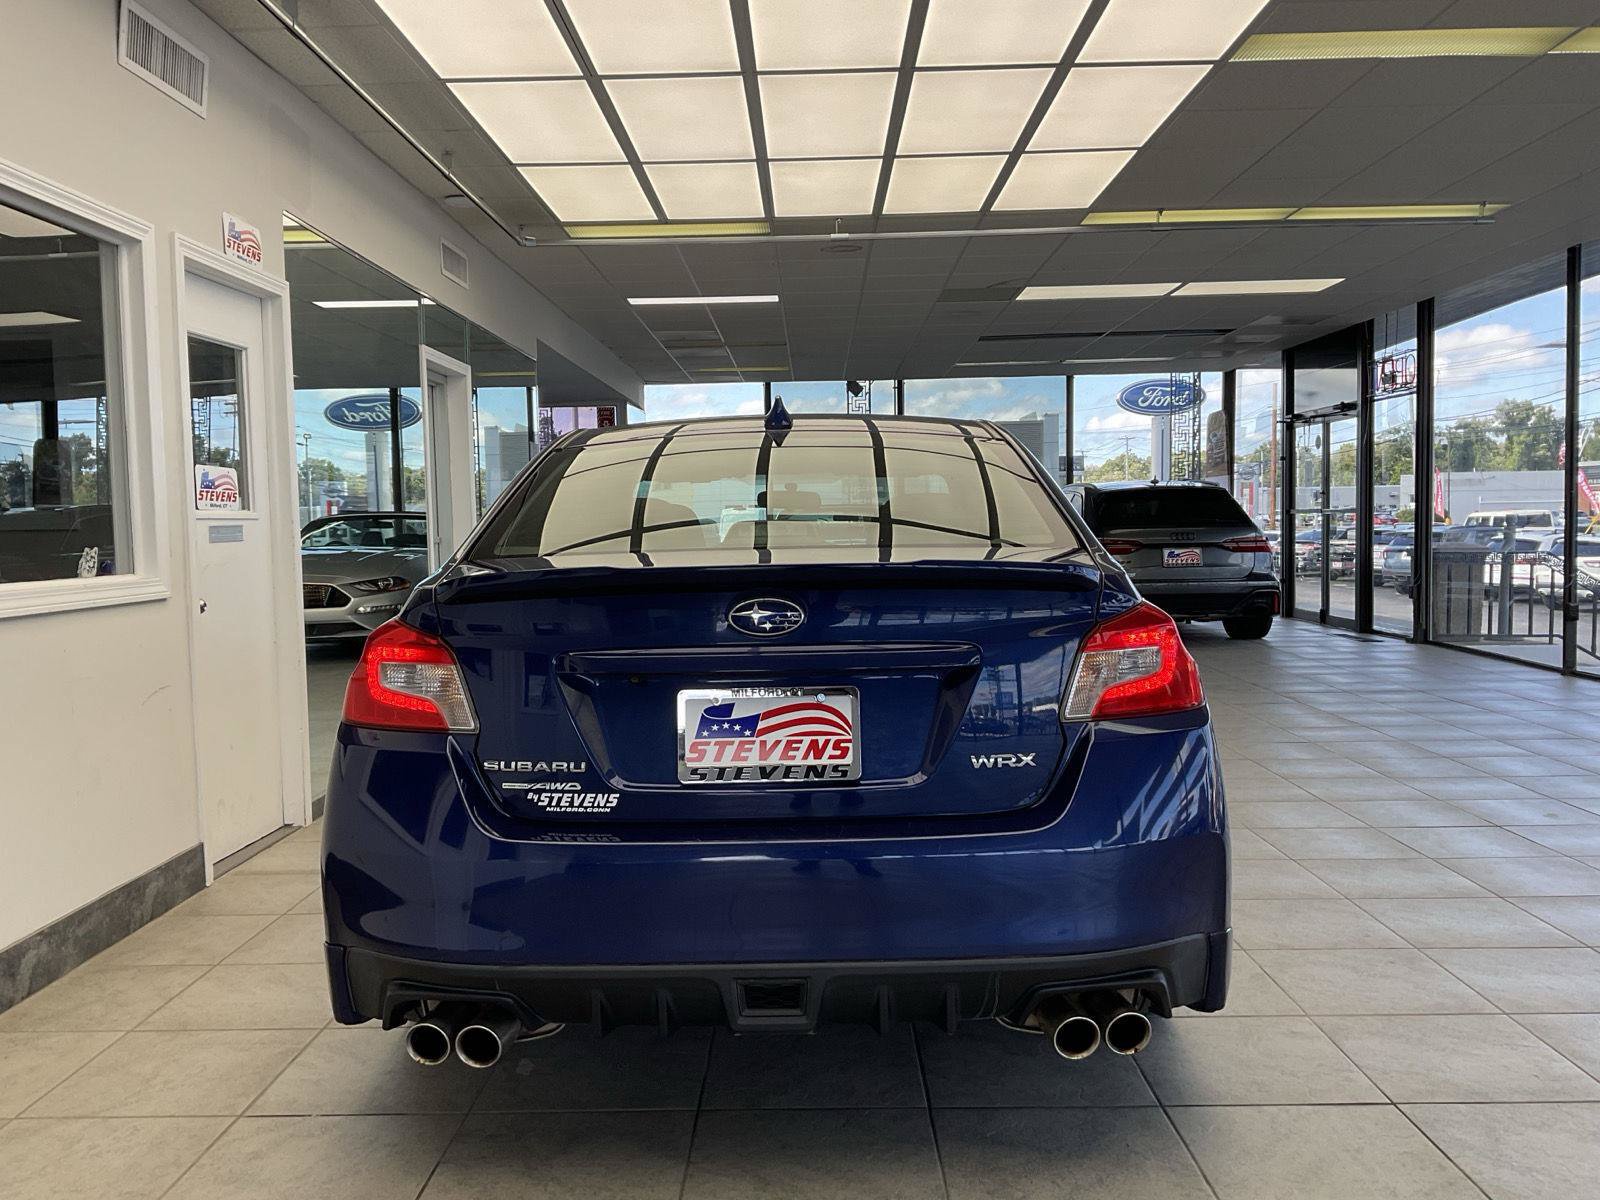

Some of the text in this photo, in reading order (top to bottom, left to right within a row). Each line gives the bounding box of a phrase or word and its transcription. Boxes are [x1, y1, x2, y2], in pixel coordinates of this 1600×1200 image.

[226, 237, 262, 262] STEVENS
[1138, 386, 1190, 407] Ford
[198, 490, 238, 503] STEVENS
[686, 738, 852, 763] STEVENS
[483, 761, 586, 773] SUBARU
[970, 752, 1037, 769] WRX
[688, 764, 851, 781] STEVENS
[531, 782, 582, 791] AWD
[537, 792, 620, 807] STEVENS
